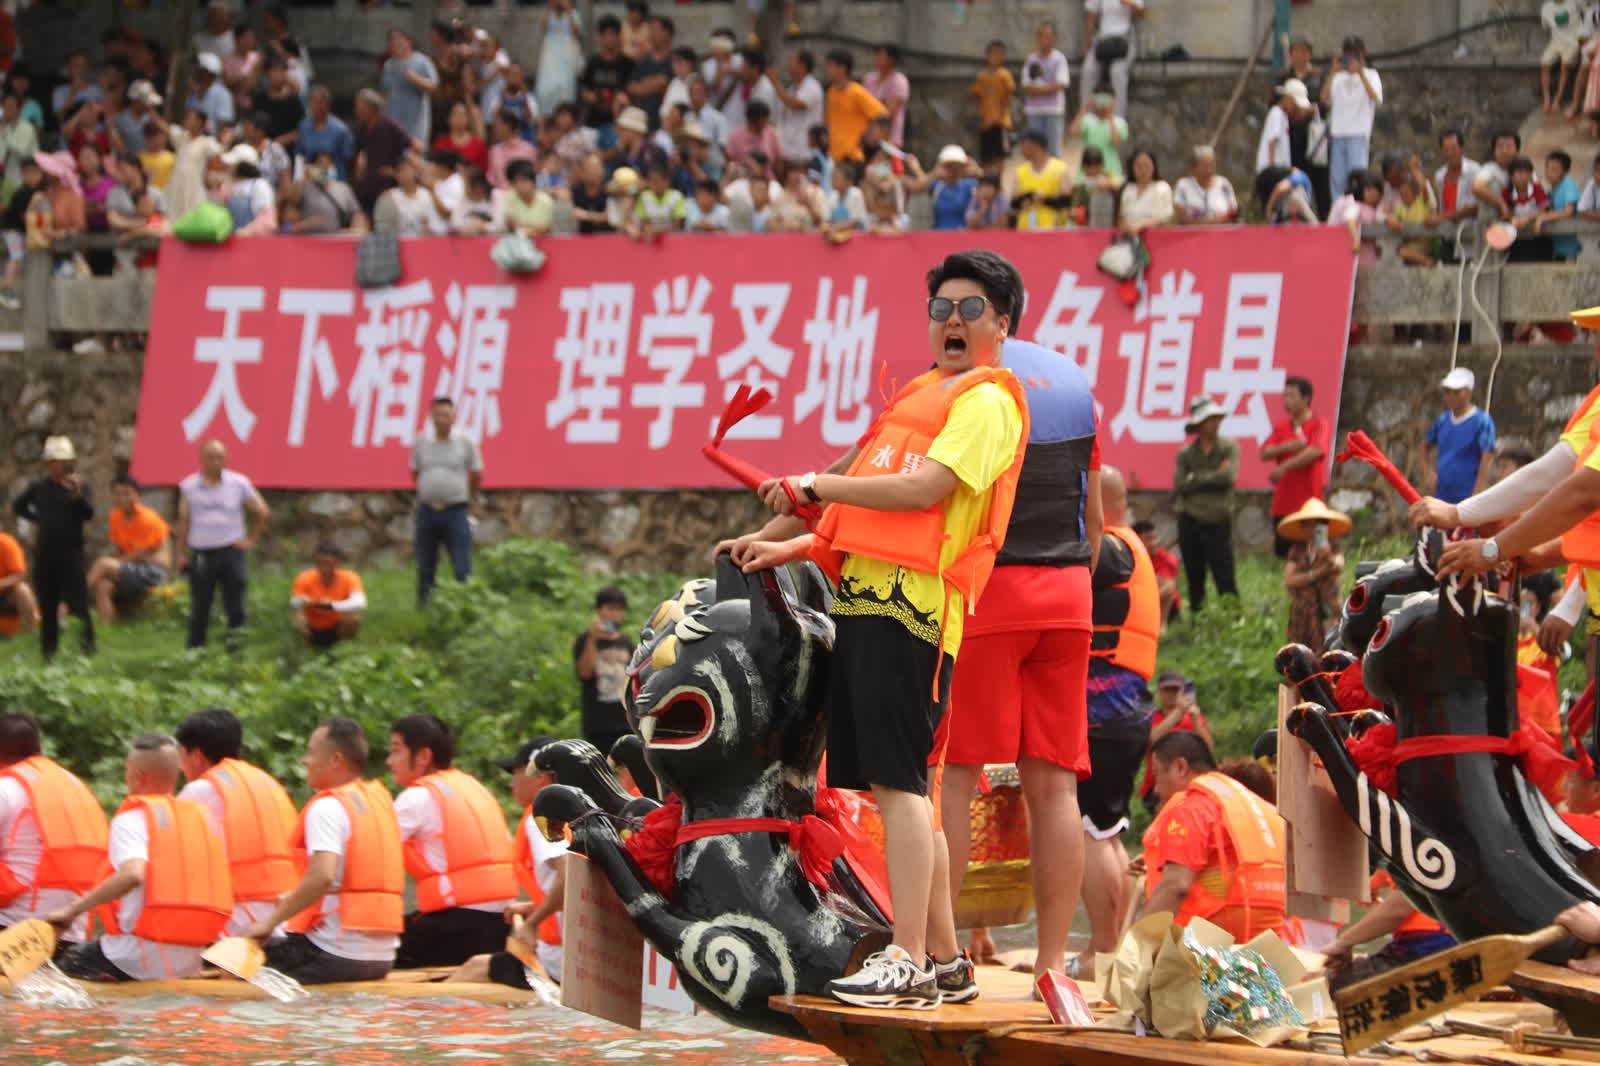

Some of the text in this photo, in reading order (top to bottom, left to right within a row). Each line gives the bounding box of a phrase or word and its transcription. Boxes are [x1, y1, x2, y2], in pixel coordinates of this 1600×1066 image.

[181, 268, 1288, 450] 天下稻源 理学圣地 色道县
